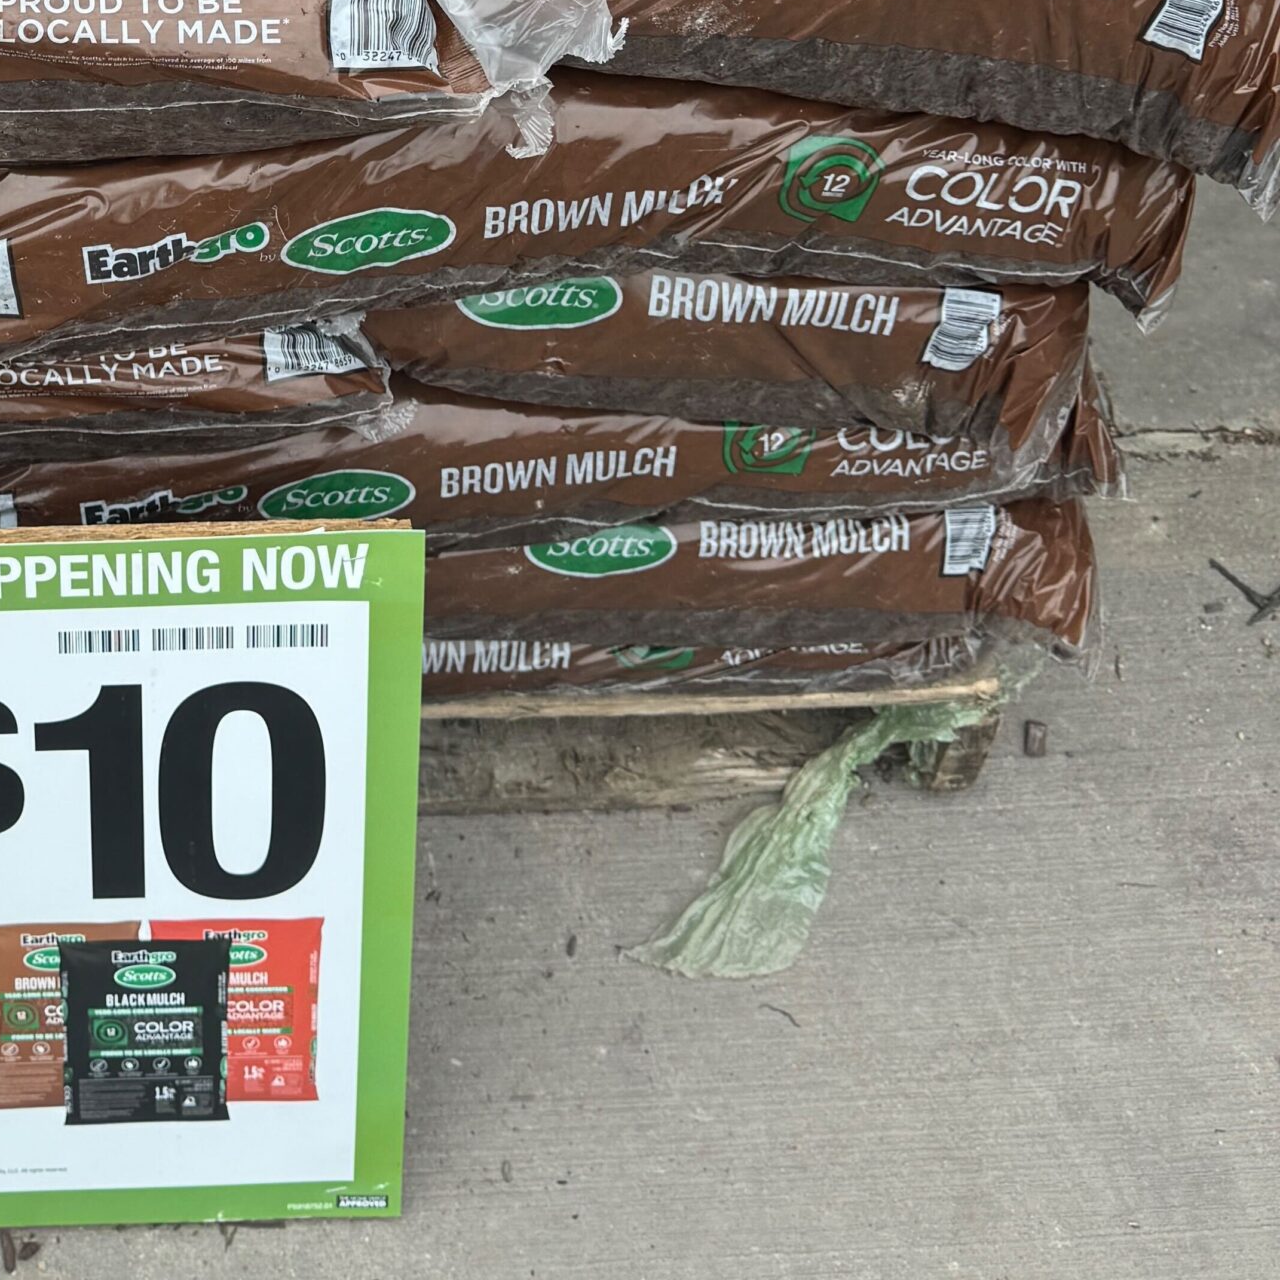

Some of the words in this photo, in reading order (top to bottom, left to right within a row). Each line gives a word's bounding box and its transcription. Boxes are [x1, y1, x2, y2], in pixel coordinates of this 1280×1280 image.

[905, 165, 1083, 220] COLOR
[649, 276, 776, 322] BROWN
[781, 286, 899, 337] MULCH
[700, 520, 807, 561] BROWN
[811, 514, 911, 559] MULCH
[242, 543, 370, 591] NOW
[473, 640, 572, 674] MULCH
[112, 950, 176, 964] Earthgro
[123, 970, 168, 983] Scotts
[106, 994, 145, 1007] BLACK
[147, 992, 185, 1006] MULCH
